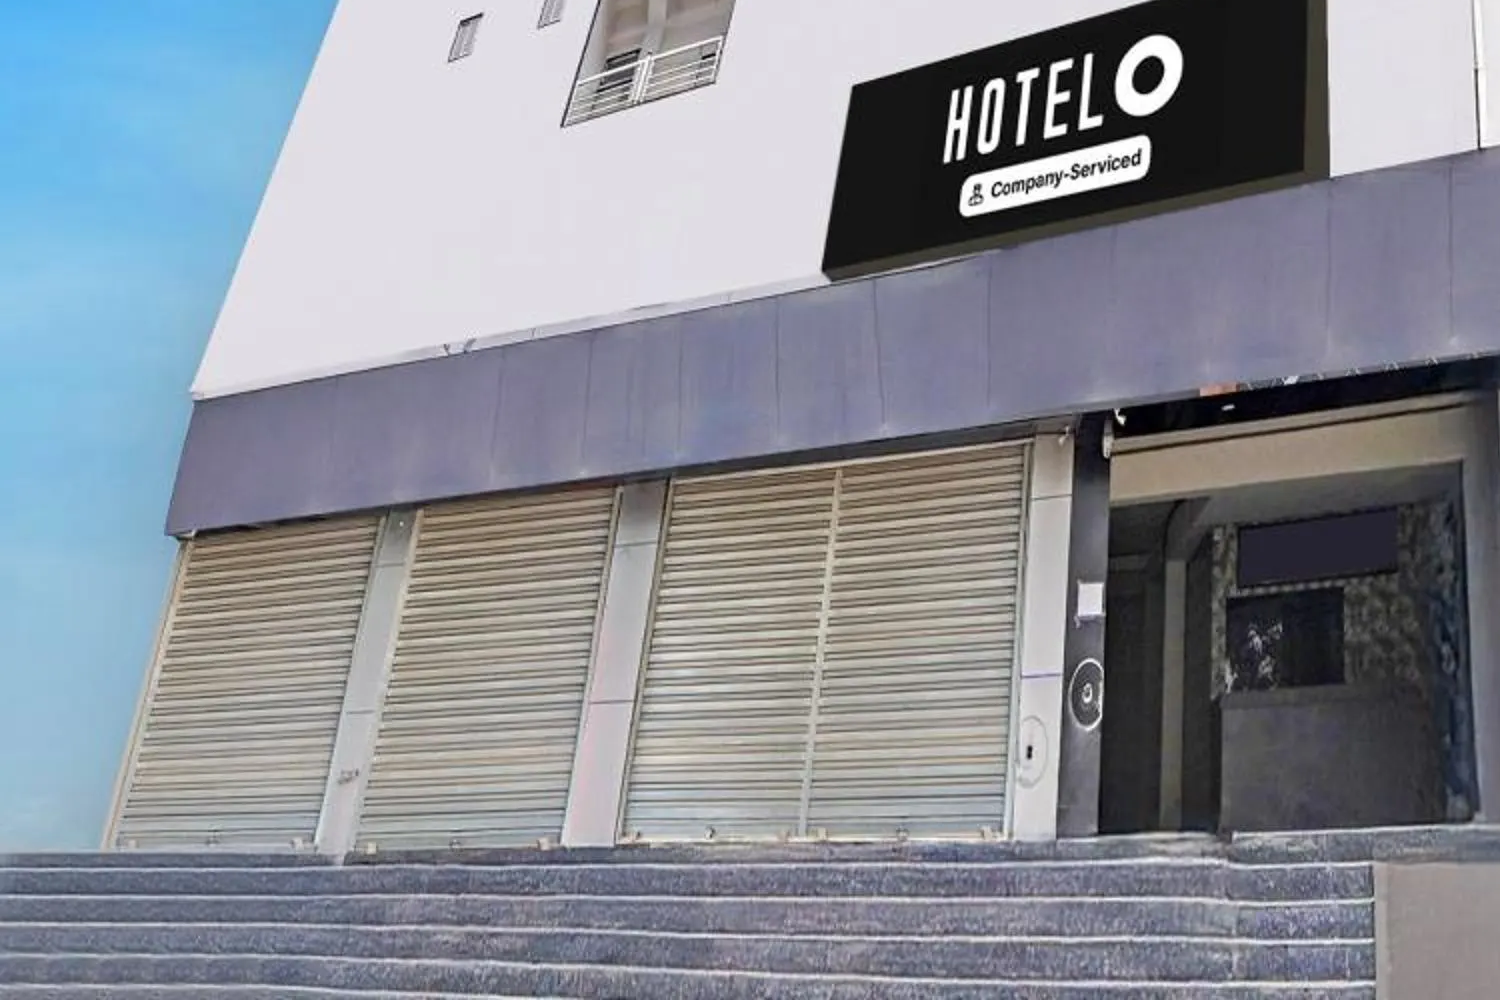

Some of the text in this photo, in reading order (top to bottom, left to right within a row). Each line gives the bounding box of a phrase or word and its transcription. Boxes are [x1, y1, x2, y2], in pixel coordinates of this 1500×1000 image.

[943, 34, 1183, 164] HOTEL O
[991, 148, 1142, 198] Company-Serviced
